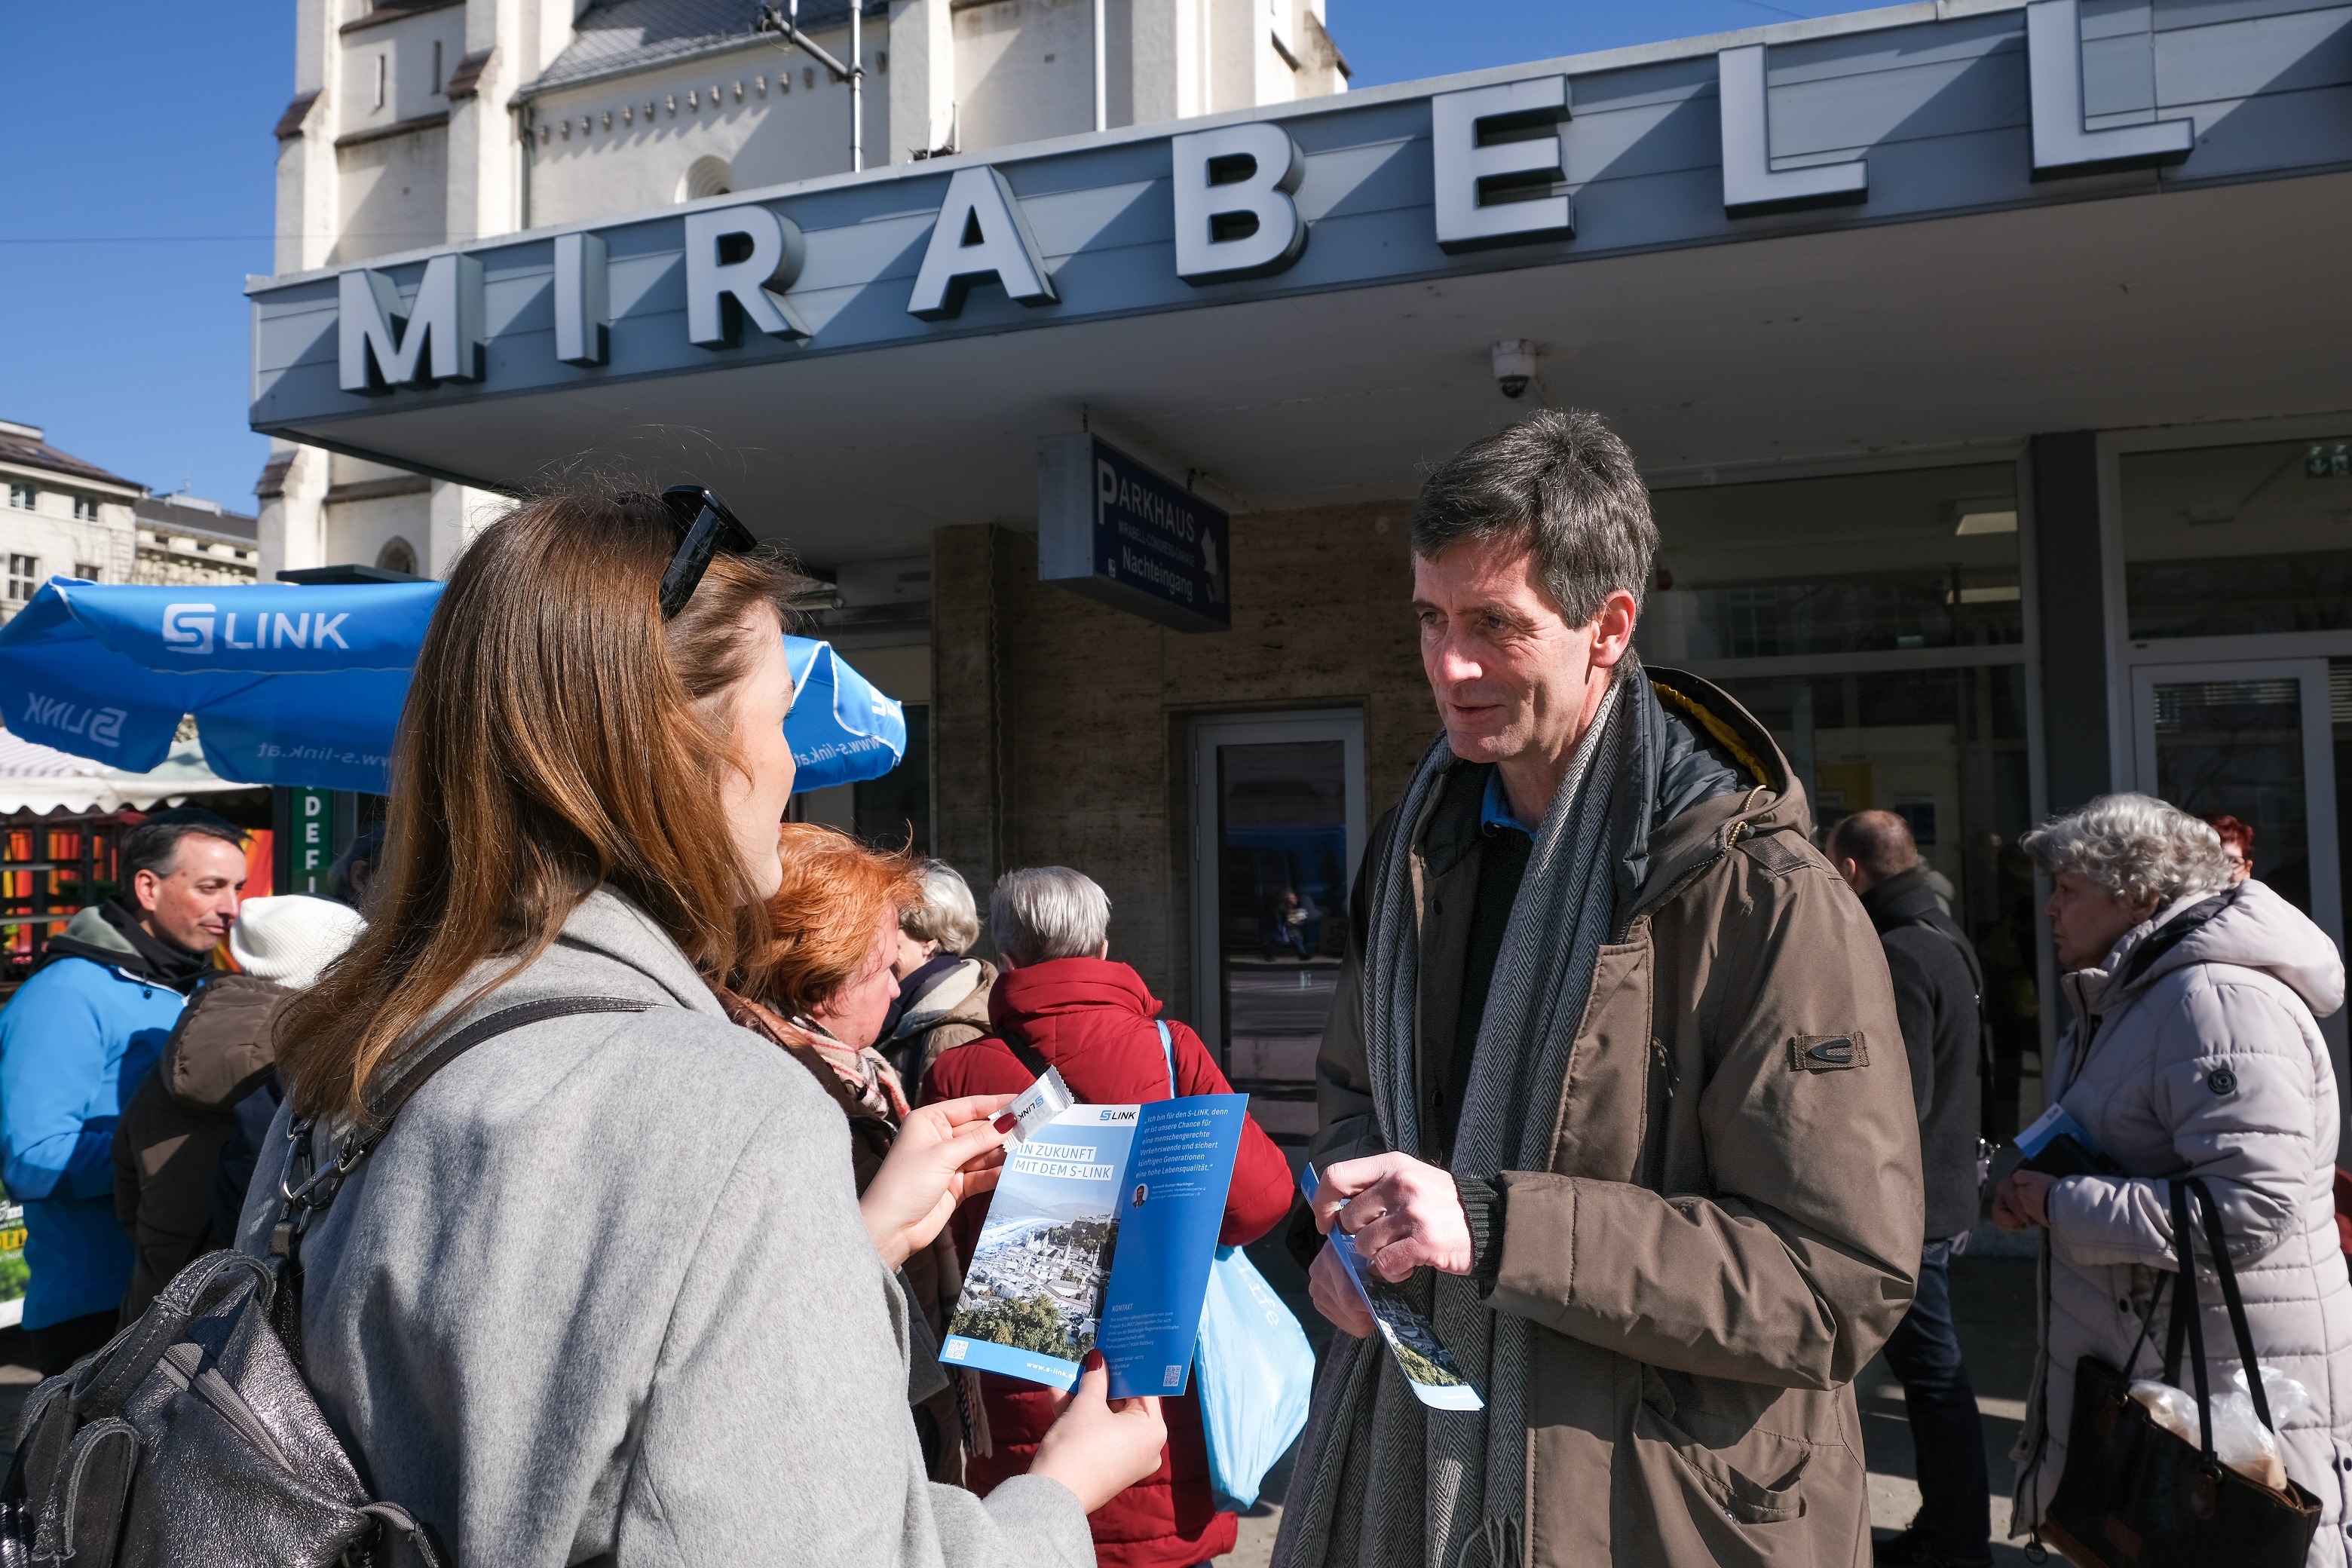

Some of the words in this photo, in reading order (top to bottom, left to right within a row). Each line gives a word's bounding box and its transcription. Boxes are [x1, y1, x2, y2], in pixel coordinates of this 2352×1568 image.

[338, 2, 2194, 395] MIRABELL
[1098, 458, 1195, 543] PARKHAUS
[1122, 545, 1193, 603] Nachteingang
[1166, 1112, 1175, 1120] für
[1187, 1109, 1210, 1118] S-LINK,
[1201, 1119, 1212, 1127] für
[1154, 1130, 1210, 1143] menschengerechte
[1035, 1145, 1094, 1160] ZUKUNFT
[1140, 1143, 1181, 1156] Verkehrswende
[1182, 1142, 1193, 1150] und
[1194, 1141, 1218, 1150] sichert
[1138, 1158, 1162, 1168] künftigen
[1163, 1153, 1205, 1164] Generationen
[1015, 1159, 1039, 1173] MIT
[1040, 1163, 1067, 1176] DEM
[1069, 1165, 1112, 1179] S-LINK
[1147, 1167, 1161, 1176] hohe
[1238, 1266, 1280, 1328] Life
[1112, 1303, 1133, 1312] KONTAKT
